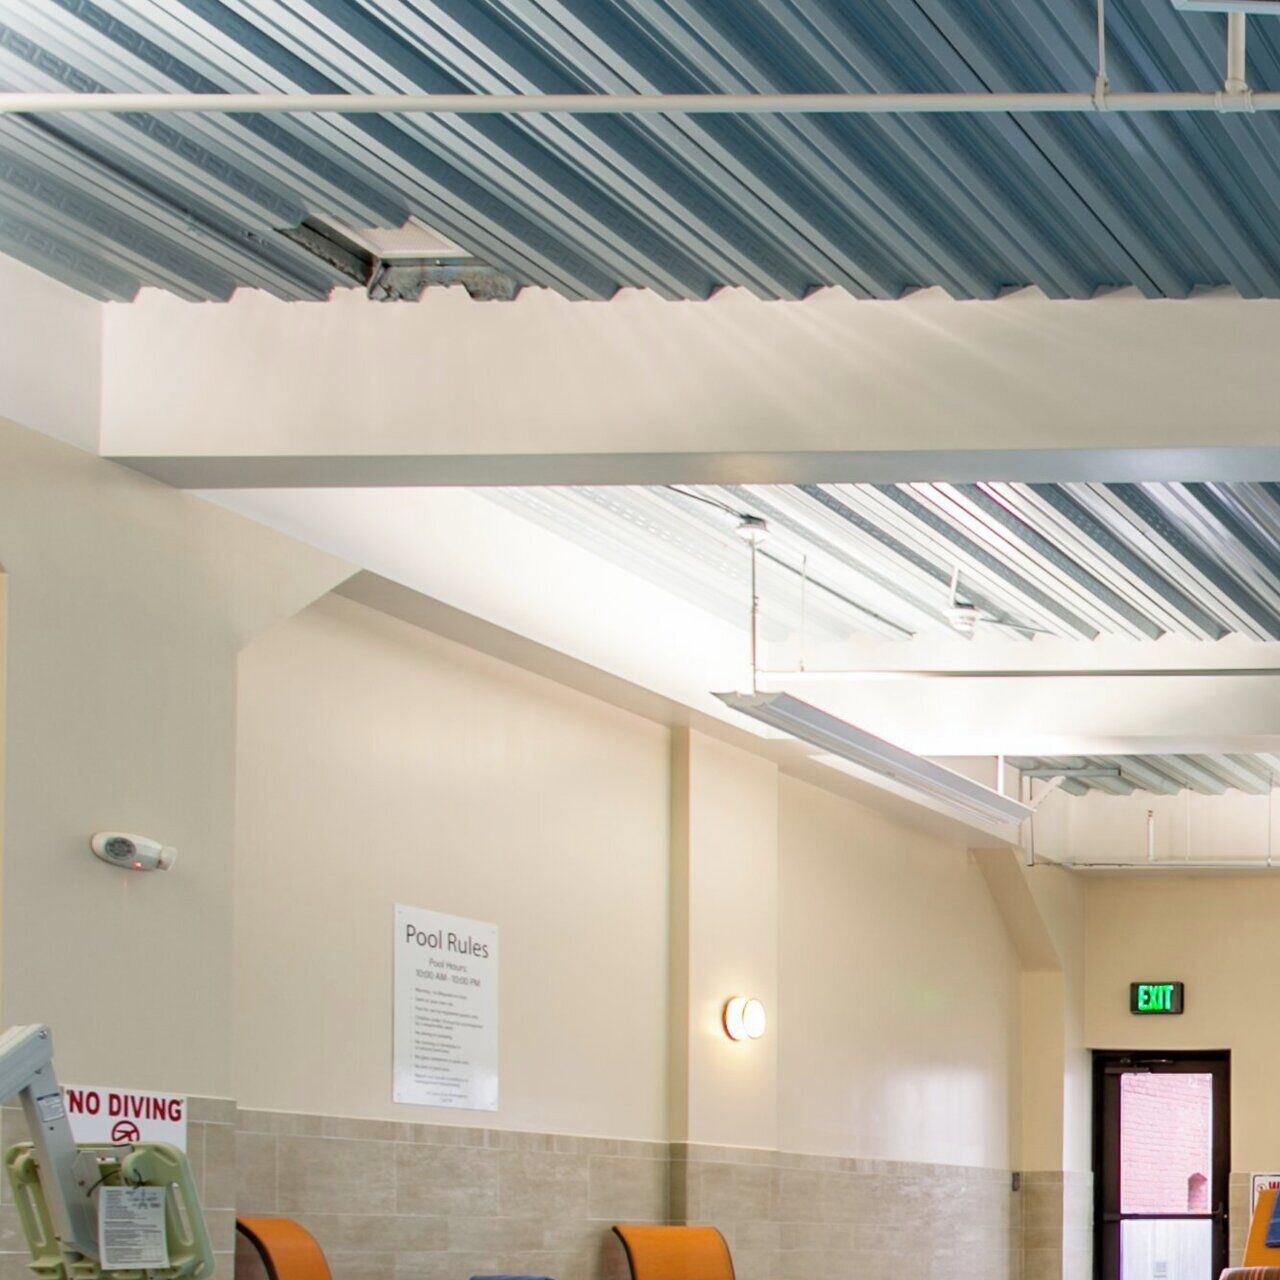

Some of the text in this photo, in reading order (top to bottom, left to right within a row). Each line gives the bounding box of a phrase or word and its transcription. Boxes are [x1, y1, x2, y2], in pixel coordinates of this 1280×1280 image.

[406, 924, 489, 959] Pool Rules
[1138, 985, 1173, 1010] EXIT
[68, 1090, 100, 1115] NO
[108, 1094, 182, 1122] DIVING
